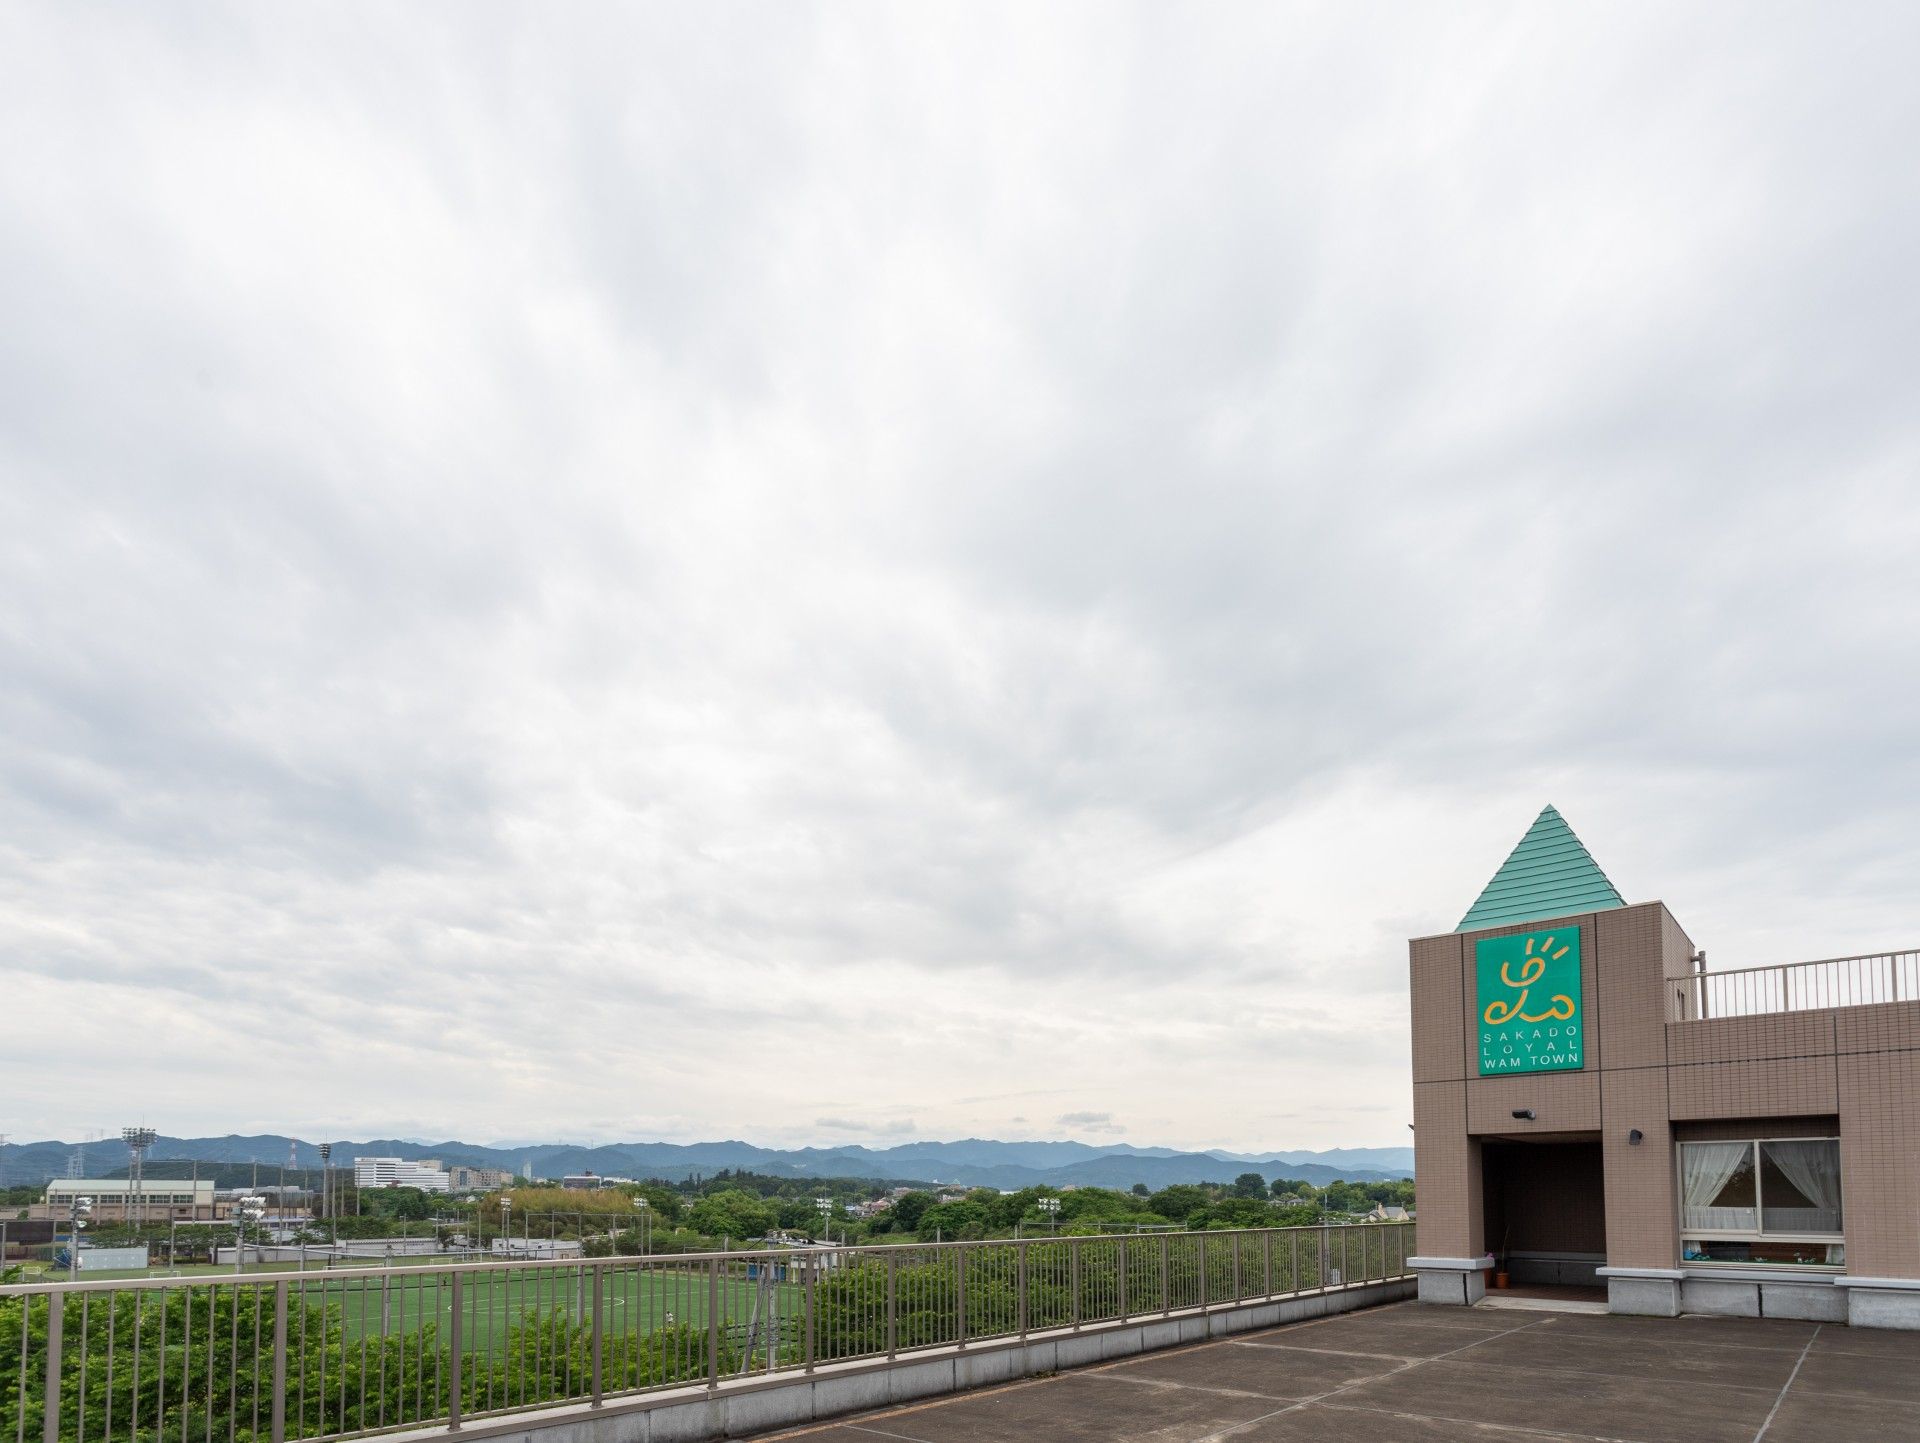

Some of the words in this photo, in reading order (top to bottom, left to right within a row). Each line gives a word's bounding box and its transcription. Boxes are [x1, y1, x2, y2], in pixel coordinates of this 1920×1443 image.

[1483, 1026, 1577, 1043] SAKADO
[1483, 1040, 1577, 1056] LOYAL
[1484, 1057, 1521, 1069] WAM
[1530, 1053, 1578, 1065] TOWN
